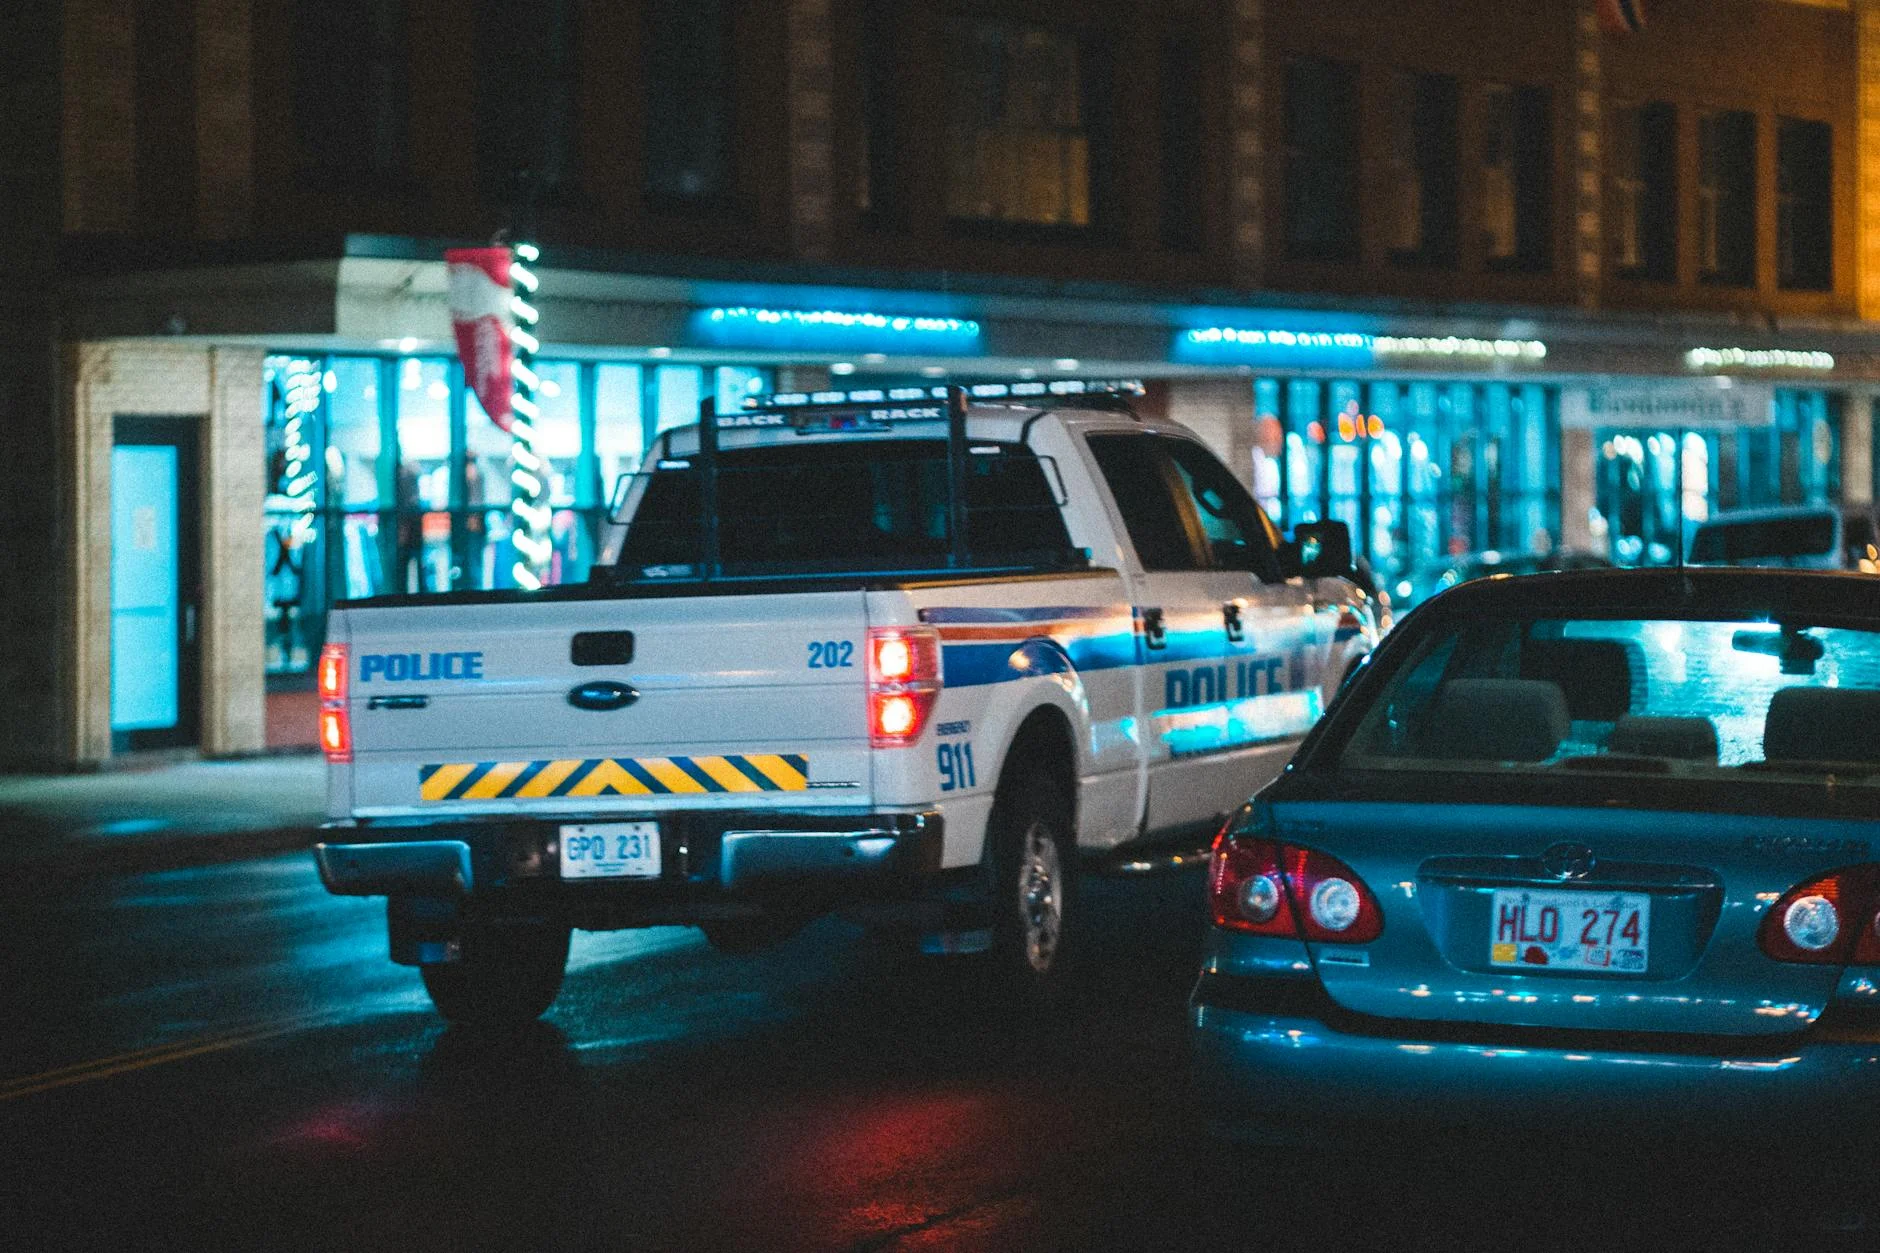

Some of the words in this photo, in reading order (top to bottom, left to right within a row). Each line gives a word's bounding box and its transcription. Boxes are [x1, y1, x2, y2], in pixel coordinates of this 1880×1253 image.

[870, 407, 941, 420] RACK
[360, 651, 483, 682] POLICE
[807, 640, 854, 669] 202
[936, 741, 977, 792] 911
[616, 833, 651, 860] 231
[1581, 908, 1641, 946] 274
